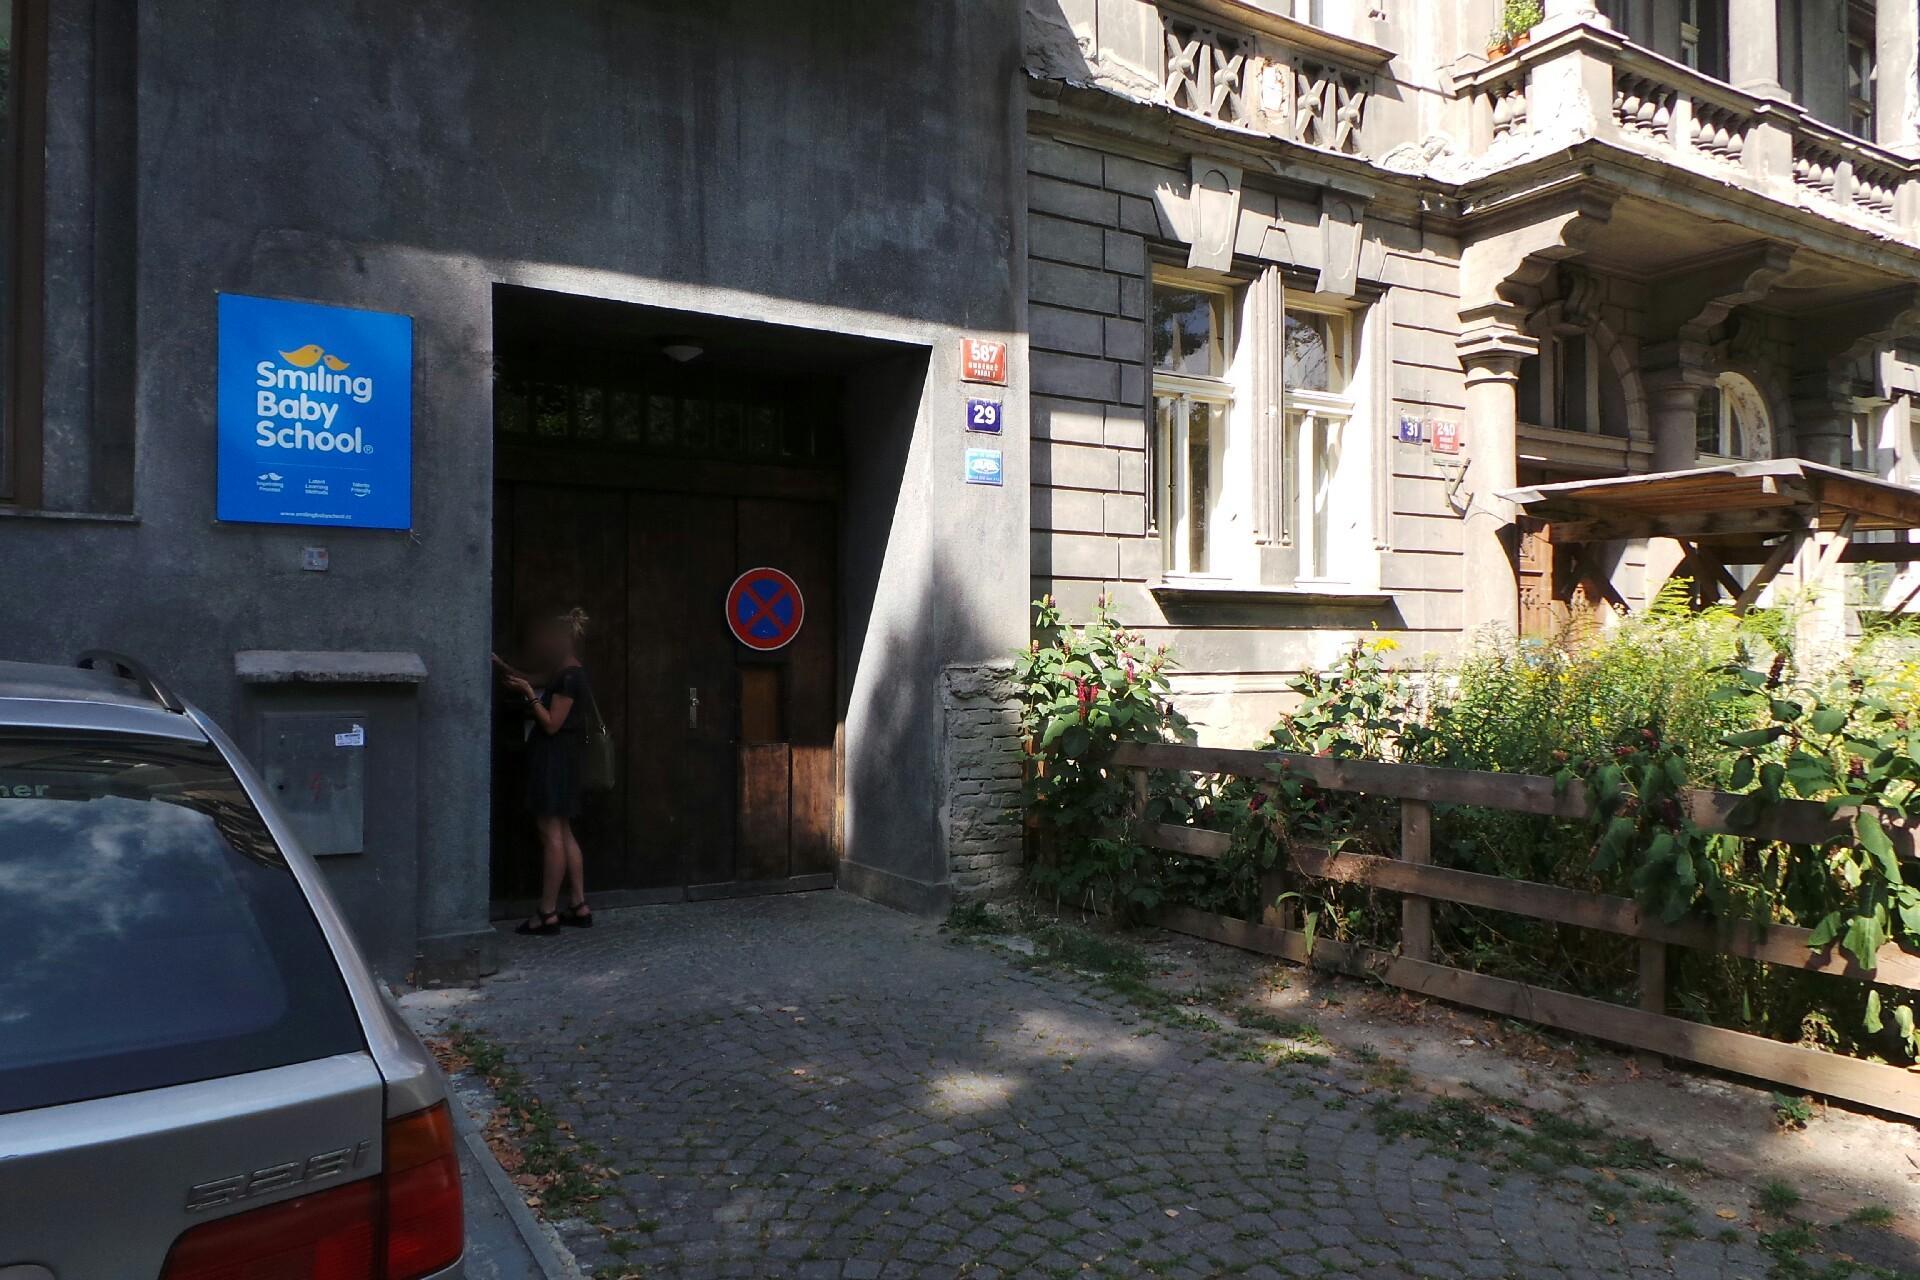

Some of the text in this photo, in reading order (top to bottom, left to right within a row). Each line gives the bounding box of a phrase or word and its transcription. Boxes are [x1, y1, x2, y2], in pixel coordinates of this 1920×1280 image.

[971, 342, 999, 363] 587
[256, 361, 373, 403] Smiling
[257, 390, 339, 429] Baby
[973, 404, 996, 425] 29
[1407, 422, 1418, 437] 31
[1437, 422, 1456, 437] 240
